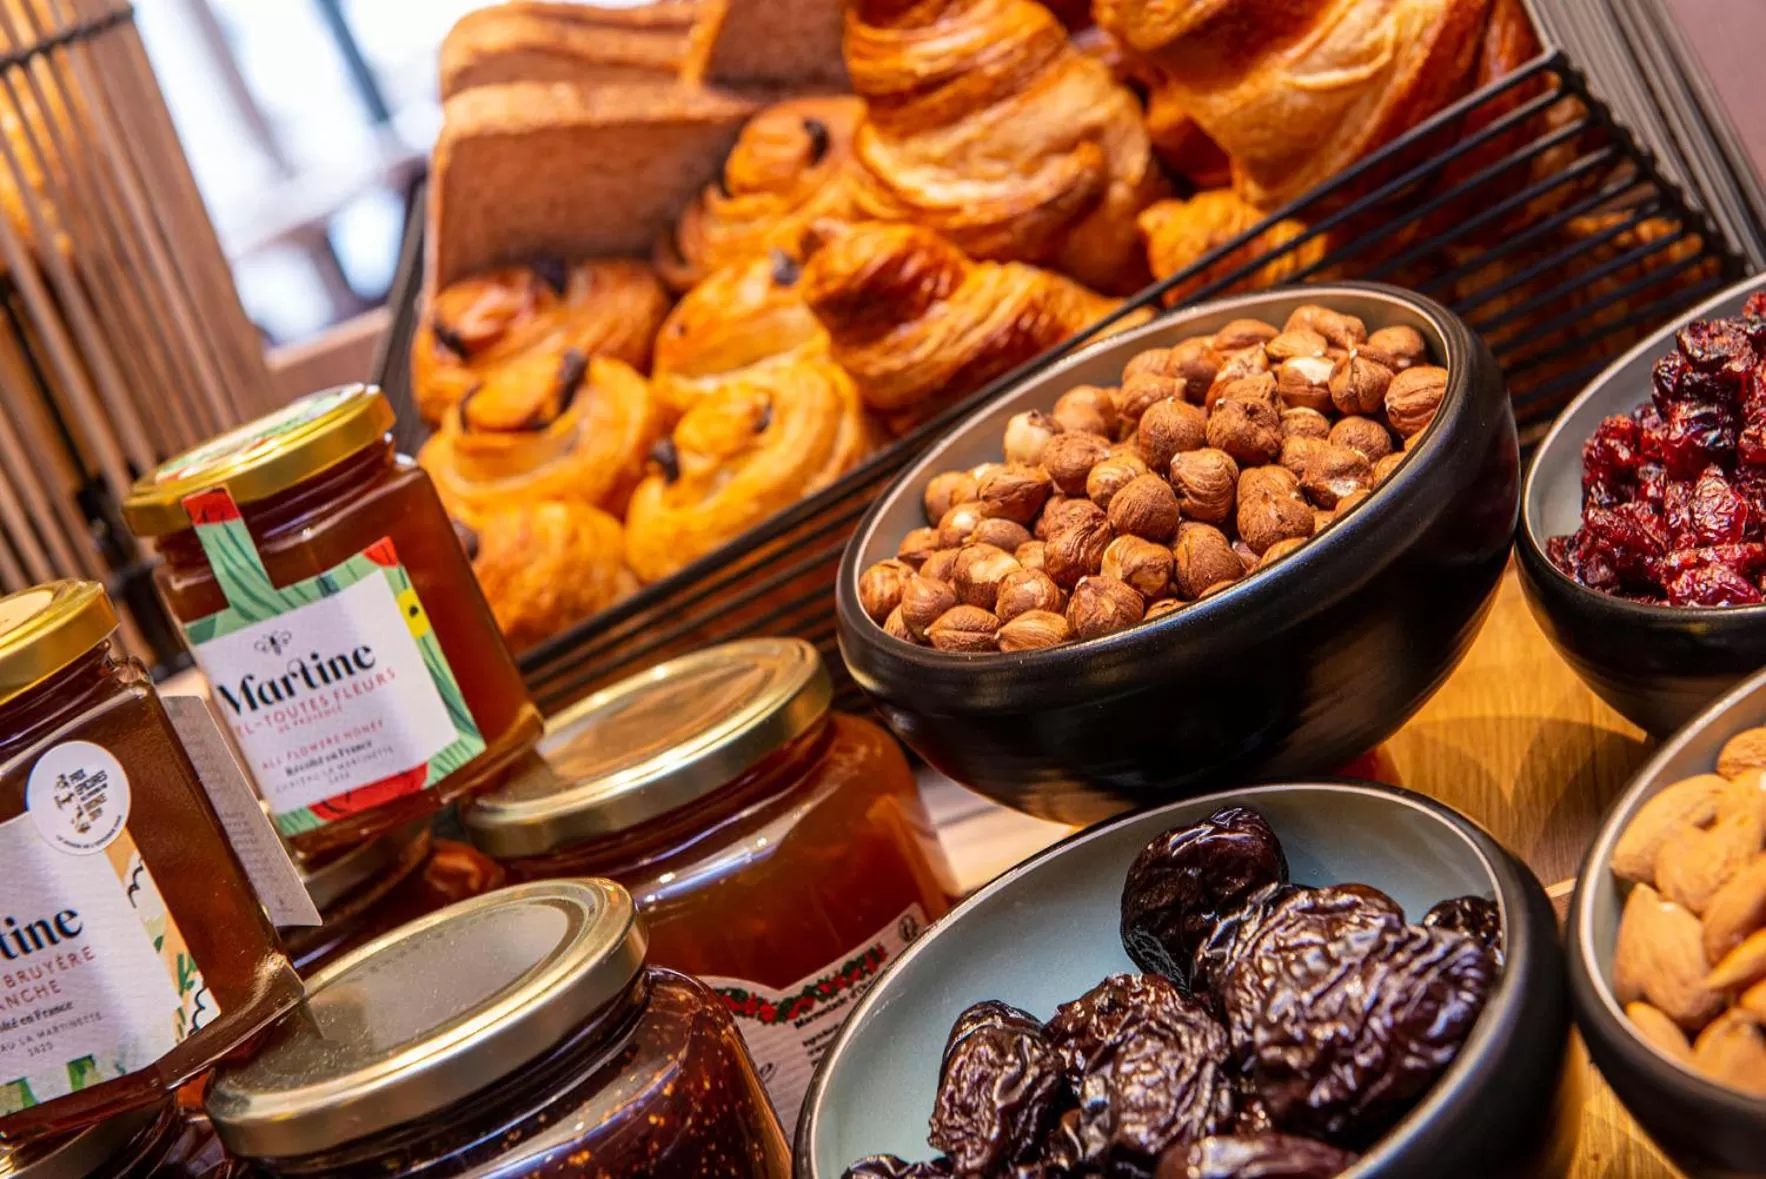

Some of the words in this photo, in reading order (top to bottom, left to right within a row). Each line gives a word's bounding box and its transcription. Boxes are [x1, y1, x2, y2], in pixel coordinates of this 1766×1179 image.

[217, 645, 376, 716] Martine
[332, 667, 397, 701] FLEURS
[3, 945, 97, 989] BRUYÈRE
[34, 1001, 74, 1021] France
